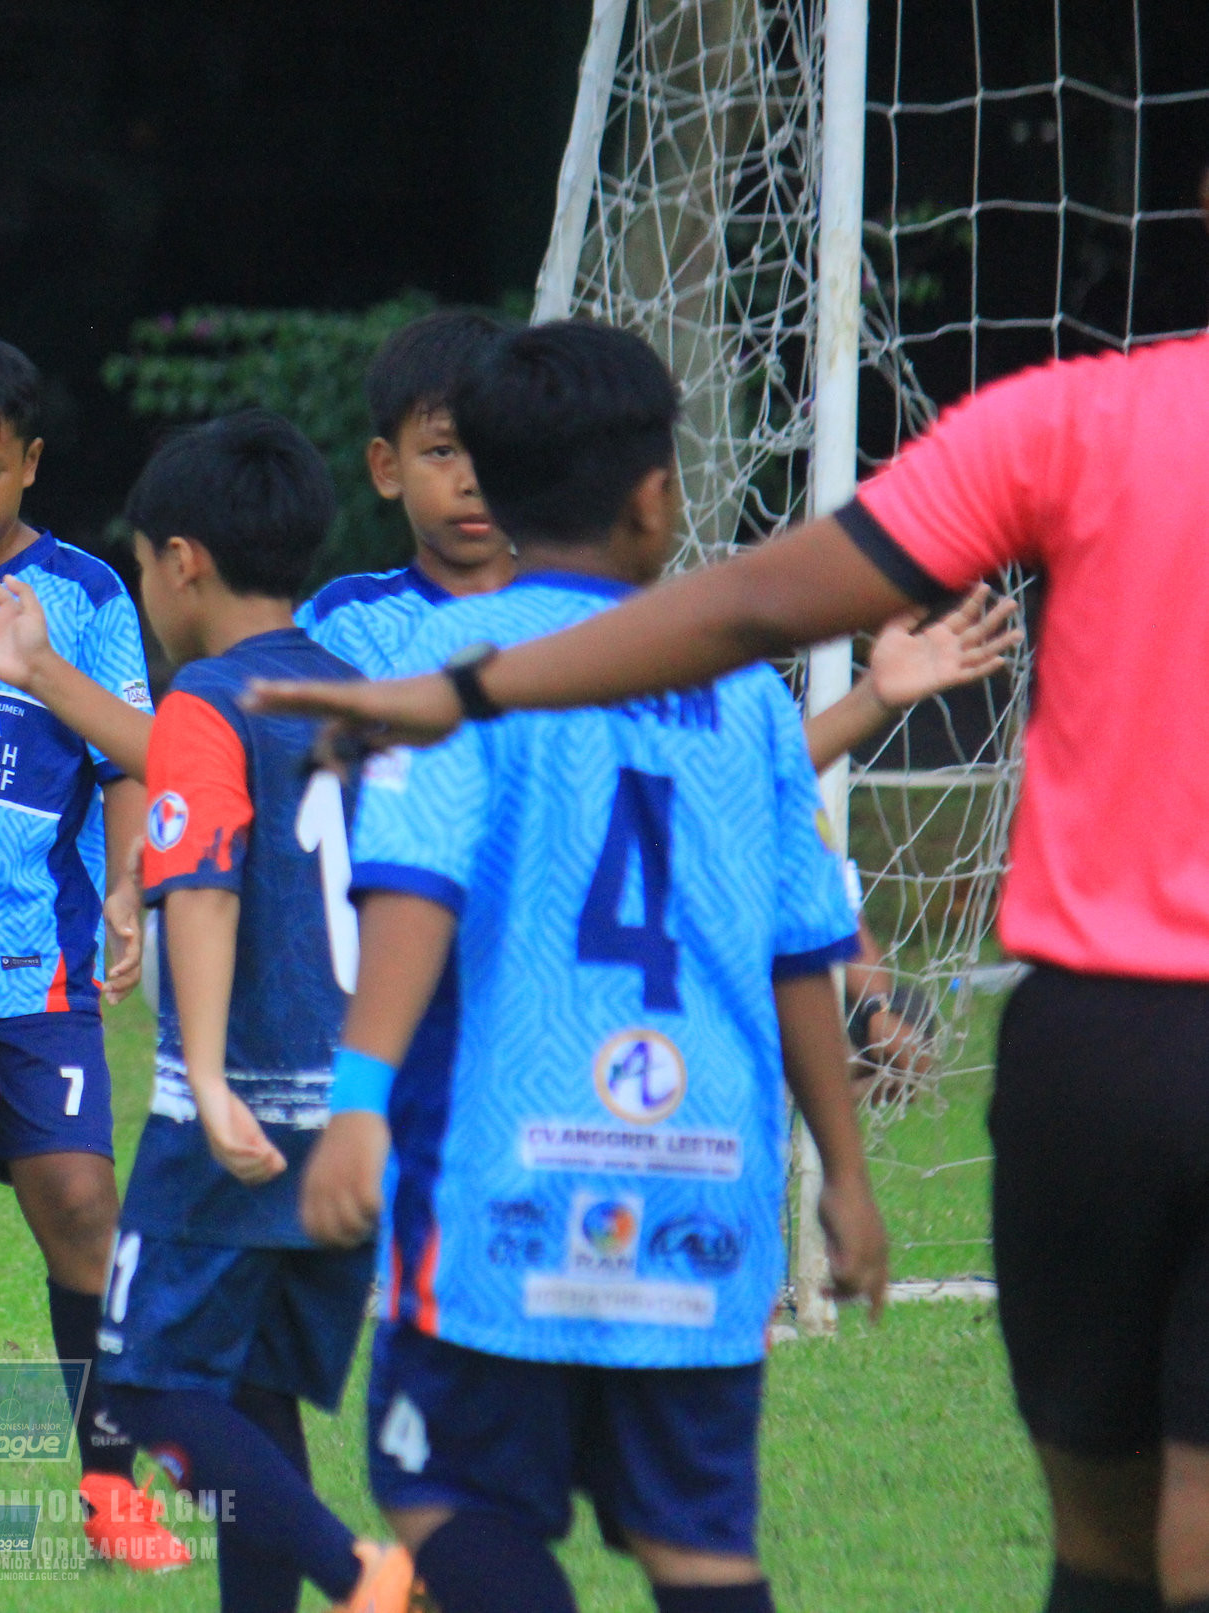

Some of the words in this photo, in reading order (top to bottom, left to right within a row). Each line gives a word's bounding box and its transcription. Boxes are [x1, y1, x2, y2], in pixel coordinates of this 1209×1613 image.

[576, 766, 681, 1013] 4
[60, 1066, 85, 1116] 7
[379, 1394, 430, 1472] 4
